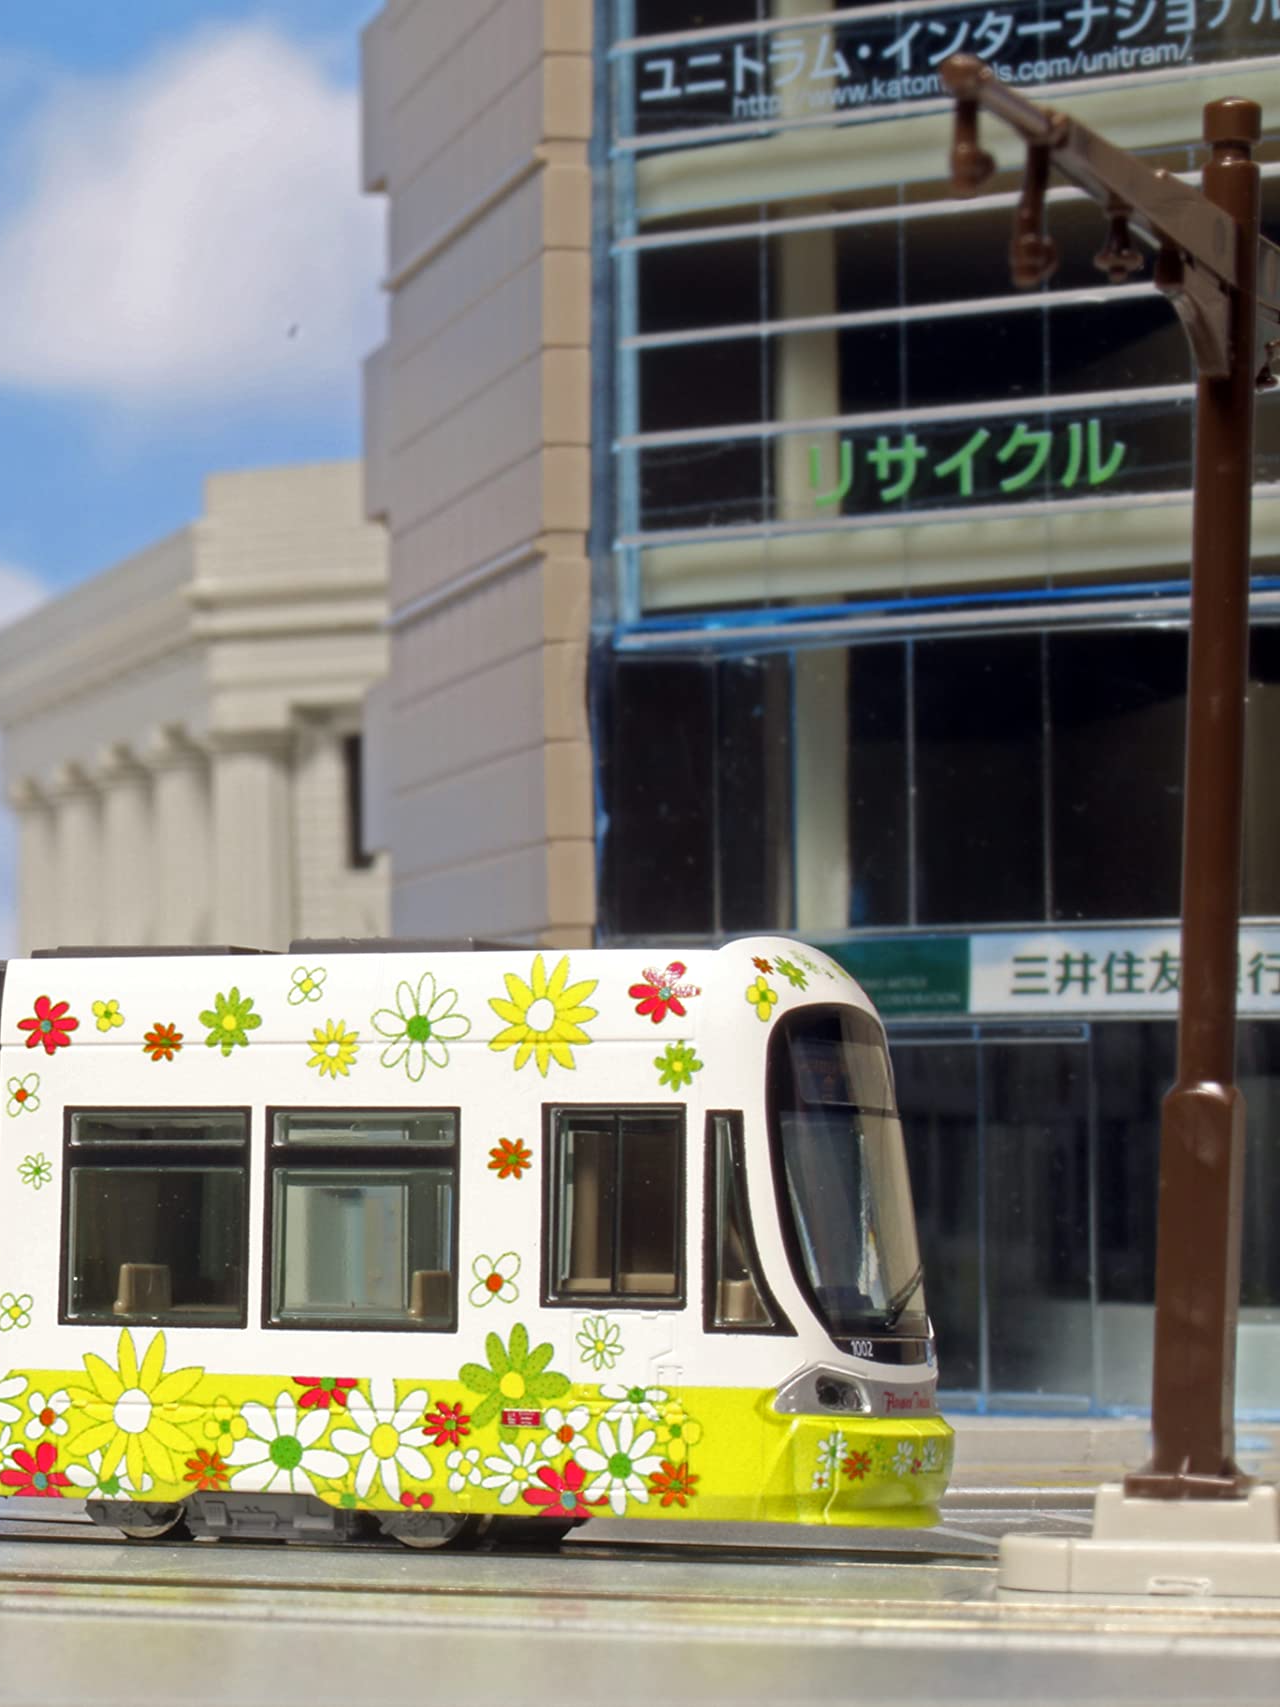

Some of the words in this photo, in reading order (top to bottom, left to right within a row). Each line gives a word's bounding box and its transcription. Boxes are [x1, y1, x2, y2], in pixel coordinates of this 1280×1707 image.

[810, 418, 1125, 507] リサイクル
[1011, 950, 1280, 996] 三井住友行
[850, 1340, 874, 1358] 1002
